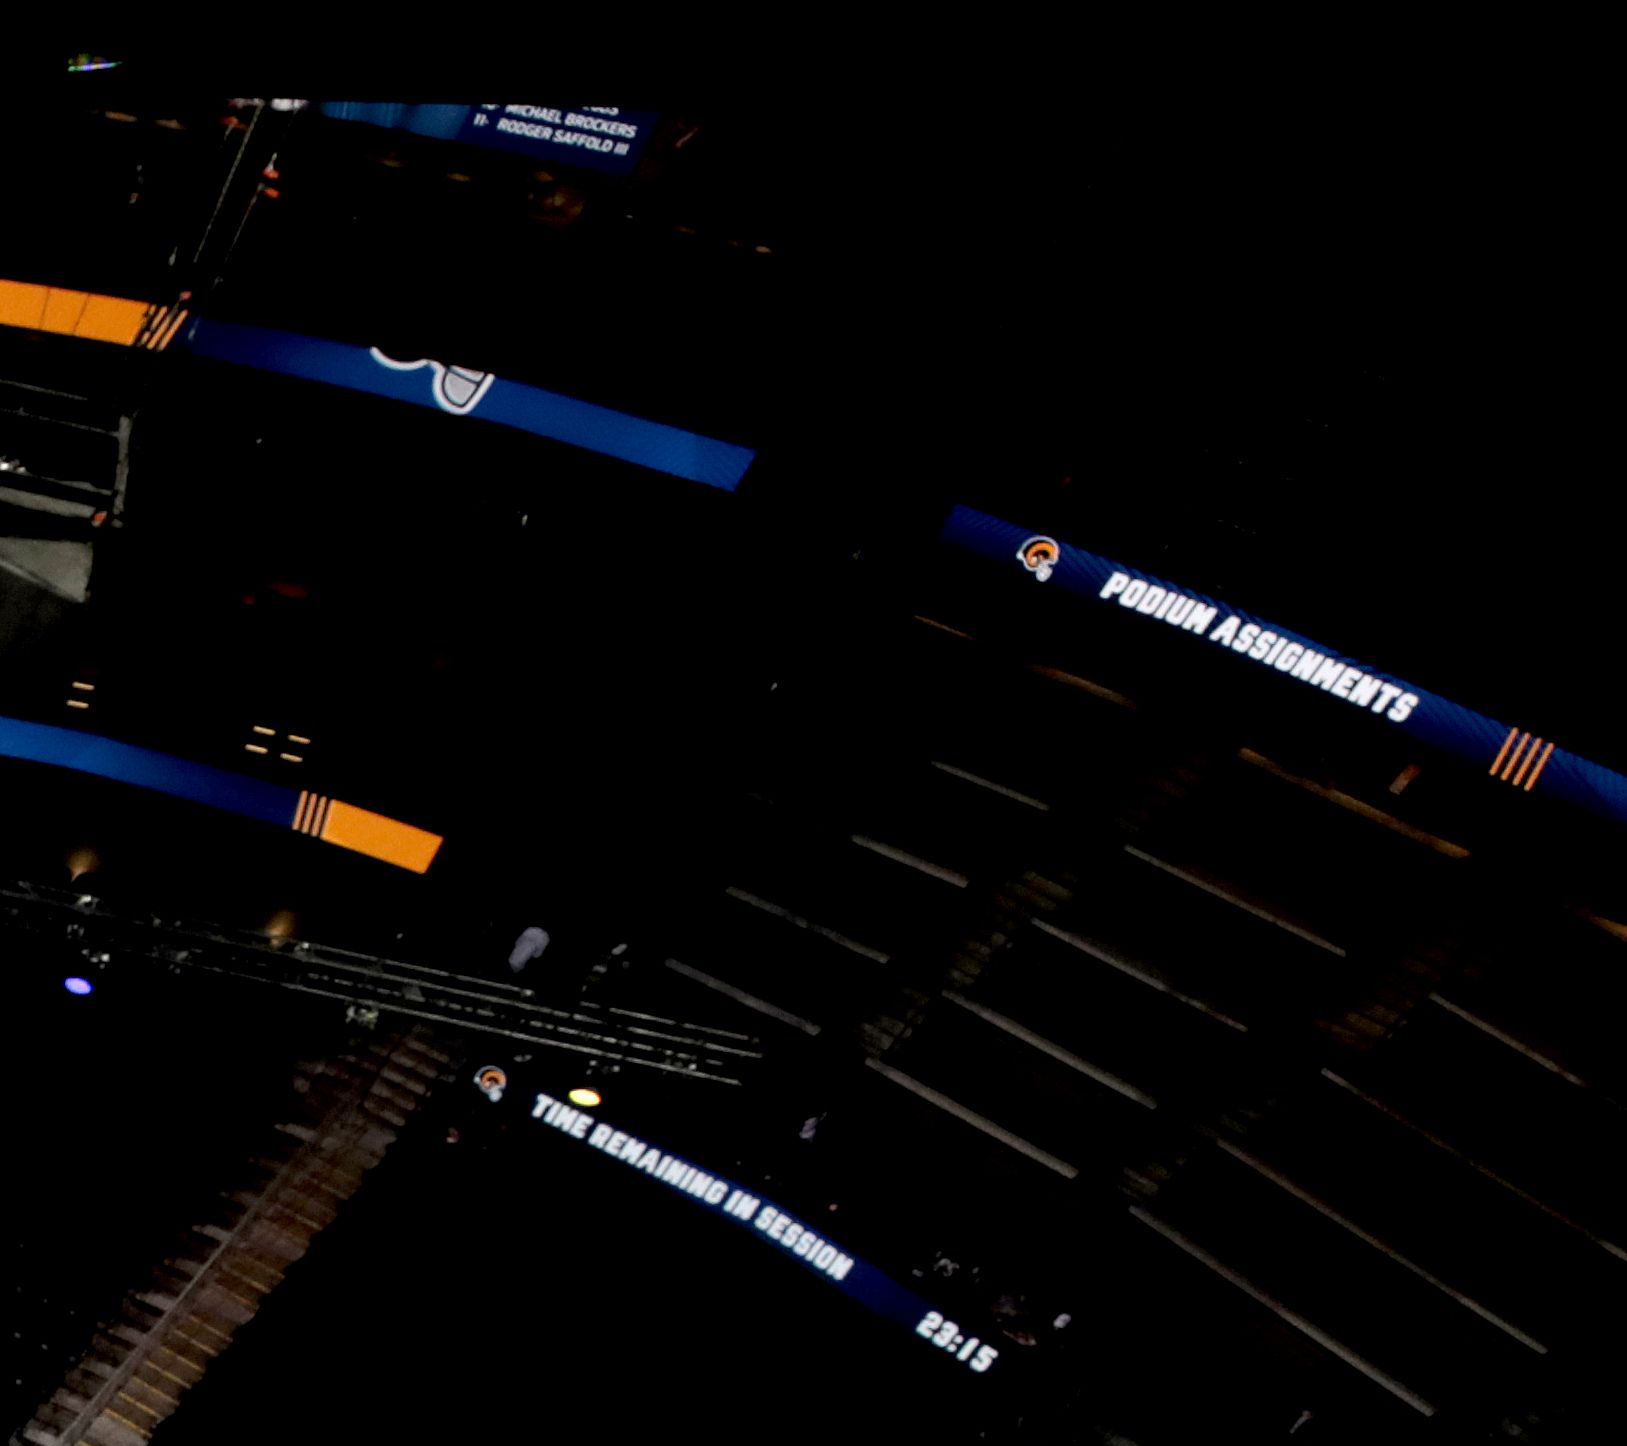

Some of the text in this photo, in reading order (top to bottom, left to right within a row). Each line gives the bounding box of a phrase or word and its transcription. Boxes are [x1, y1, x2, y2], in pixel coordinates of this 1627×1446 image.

[496, 117, 553, 142] RODGER
[551, 124, 614, 154] SAFFOLD
[564, 107, 638, 139] BROCKERS
[1099, 570, 1419, 723] PODIUM ASSIGNMENTS
[532, 1093, 999, 1373] TIME REMAINING IN SESSION 23:15
